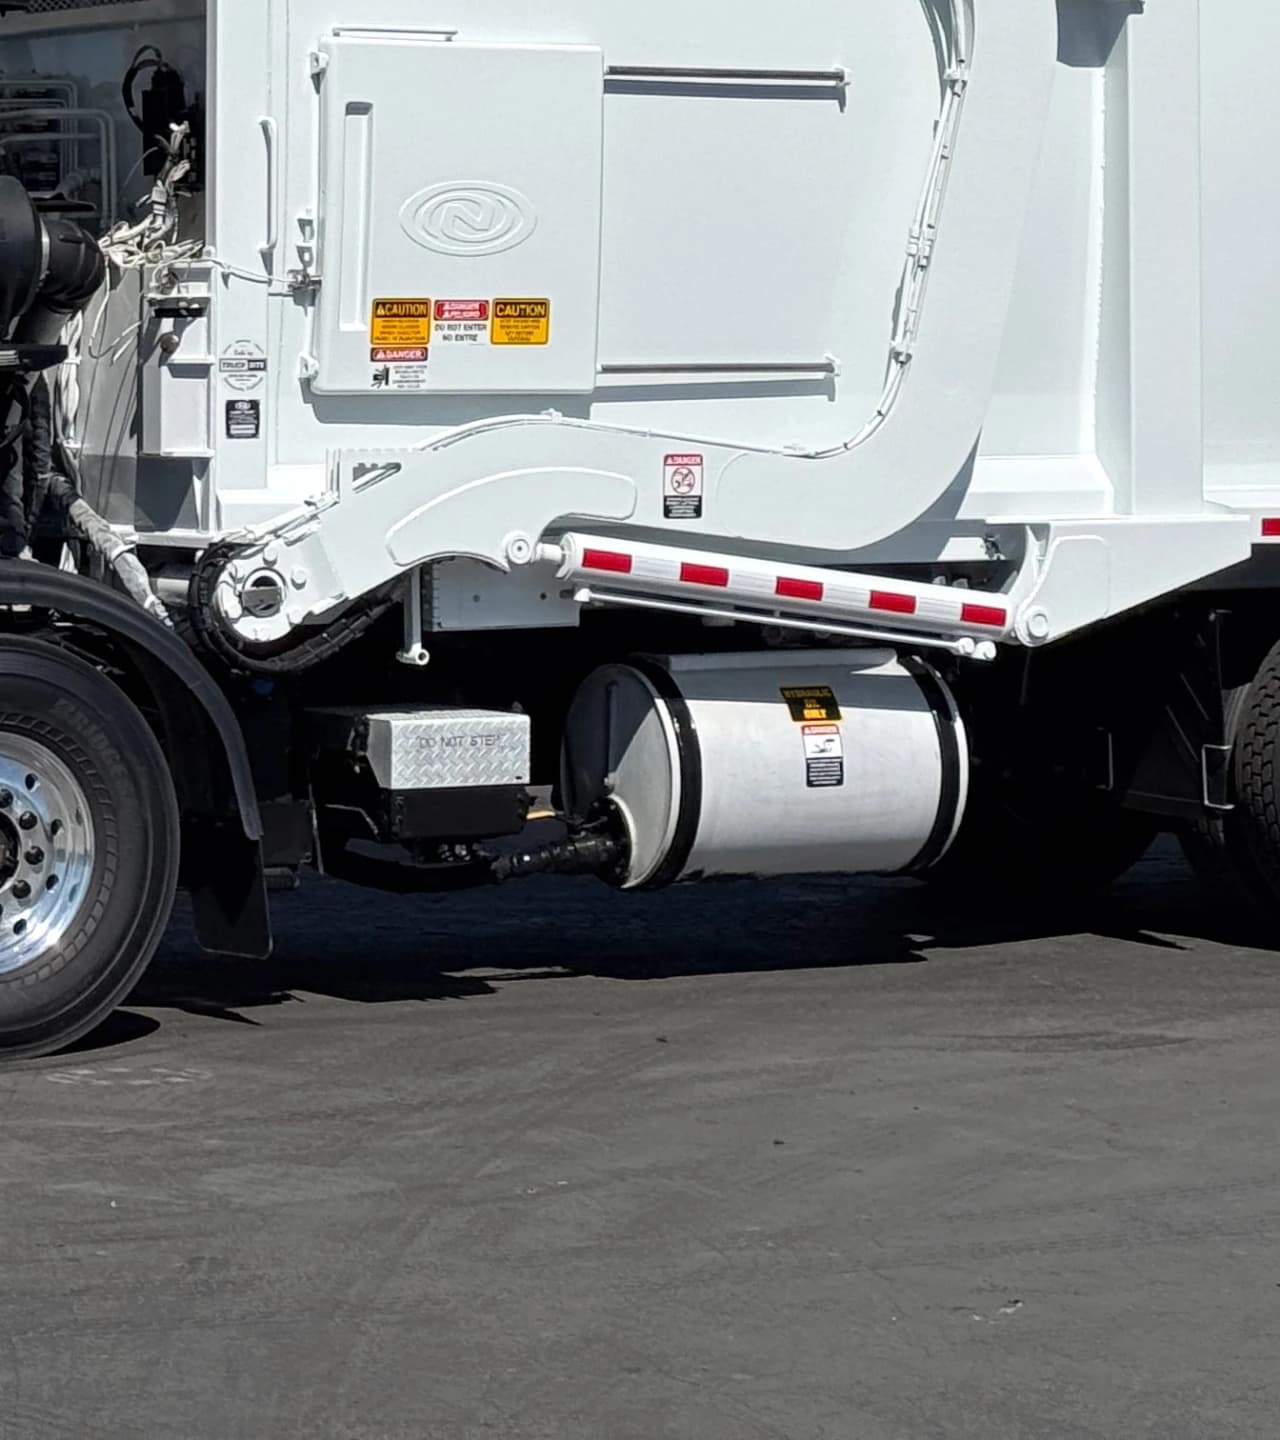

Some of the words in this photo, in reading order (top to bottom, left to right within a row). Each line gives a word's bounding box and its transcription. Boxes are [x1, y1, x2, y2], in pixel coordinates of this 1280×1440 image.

[385, 303, 427, 317] CAUTION
[496, 303, 546, 317] CAUTION
[463, 323, 488, 332] ENTER
[419, 737, 437, 749] DO
[440, 735, 465, 748] NOT
[469, 734, 501, 747] STEP
